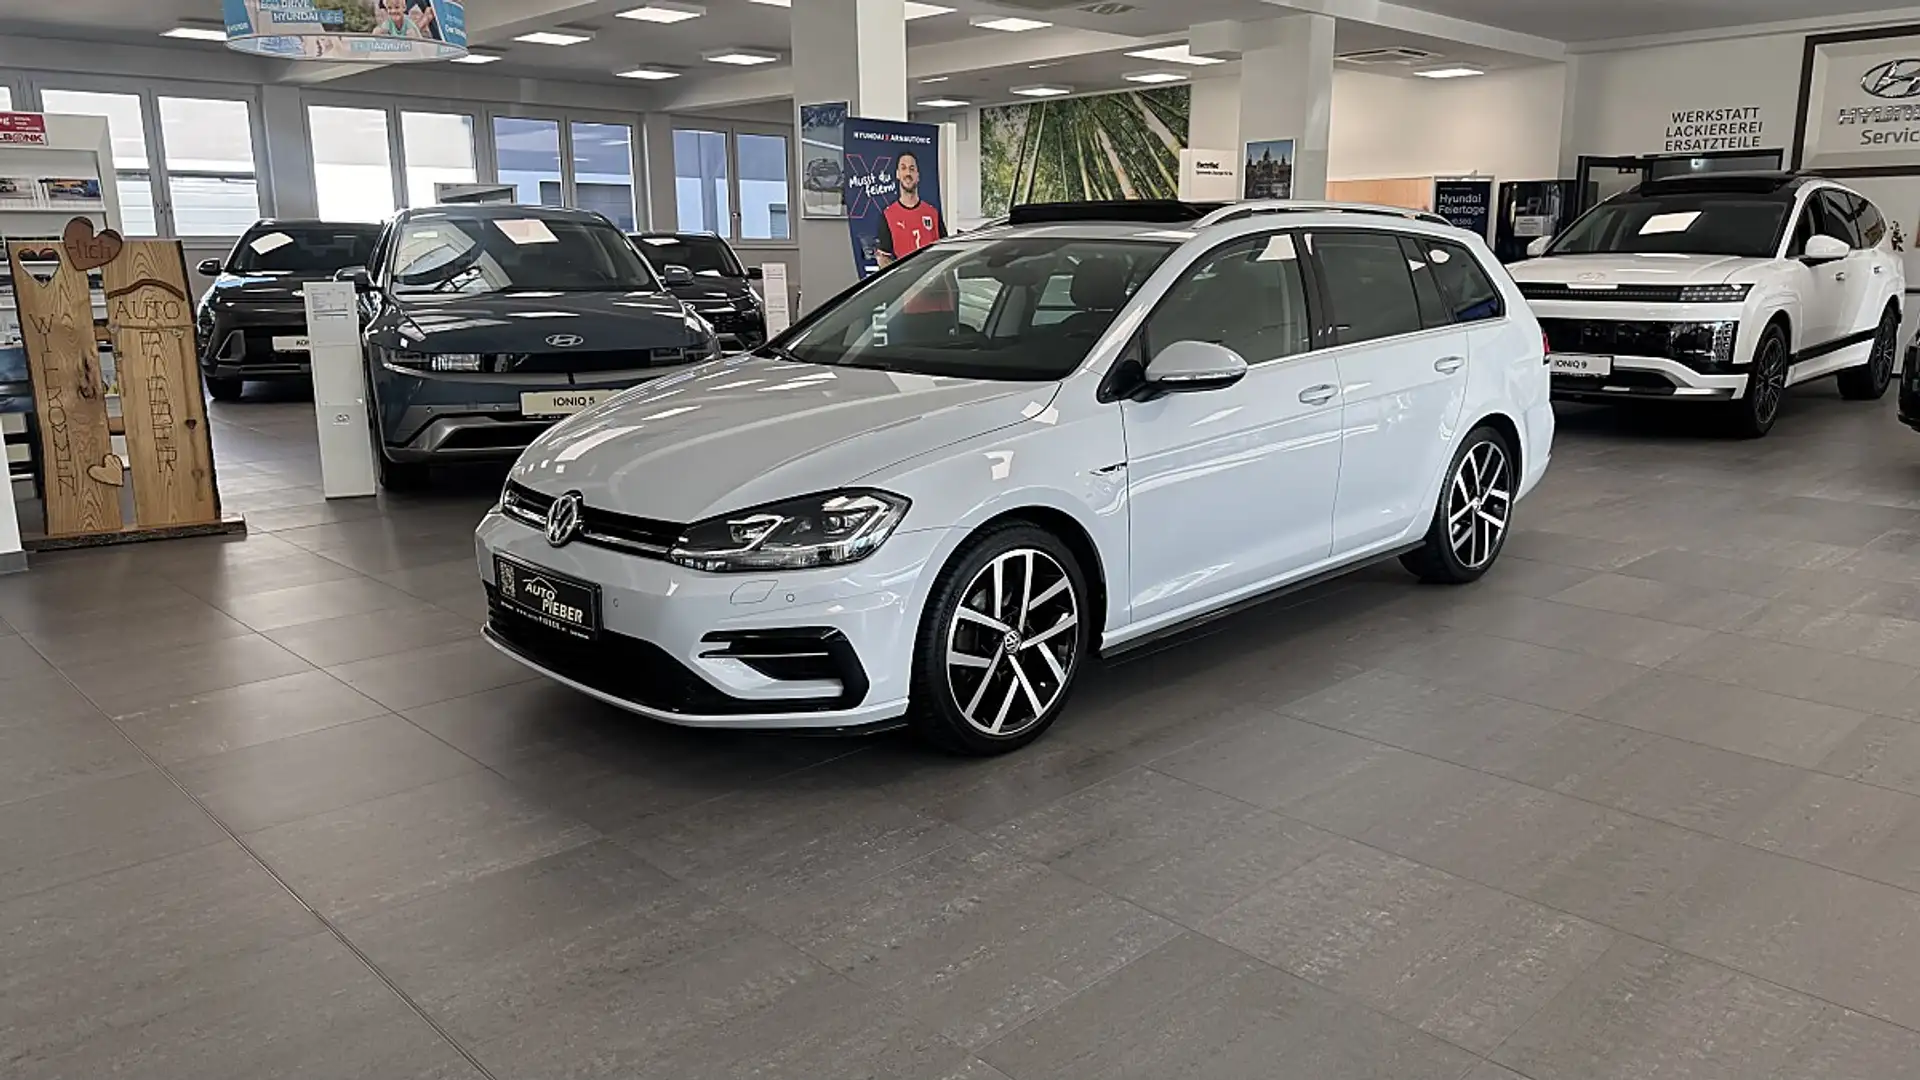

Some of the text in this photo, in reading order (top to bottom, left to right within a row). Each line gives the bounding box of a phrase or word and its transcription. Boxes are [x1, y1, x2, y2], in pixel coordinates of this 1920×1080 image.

[273, 11, 319, 21] HYUNDAI
[1671, 107, 1760, 124] WERKSTATT
[853, 131, 885, 141] HYUNDAI
[1665, 121, 1763, 138] LACKIEREREI
[1860, 127, 1920, 145] Servic
[1664, 135, 1761, 152] ERSATZTEILE
[849, 170, 892, 188] Musst du
[865, 182, 897, 197] feiern!
[1439, 193, 1482, 205] Hyundai
[1438, 204, 1487, 216] Feiertage
[114, 300, 181, 320] AUTO
[1554, 360, 1580, 369] IONIQ
[553, 396, 595, 407] IONIQ 5
[524, 582, 555, 600] AUTO
[542, 599, 583, 624] PIEBER
